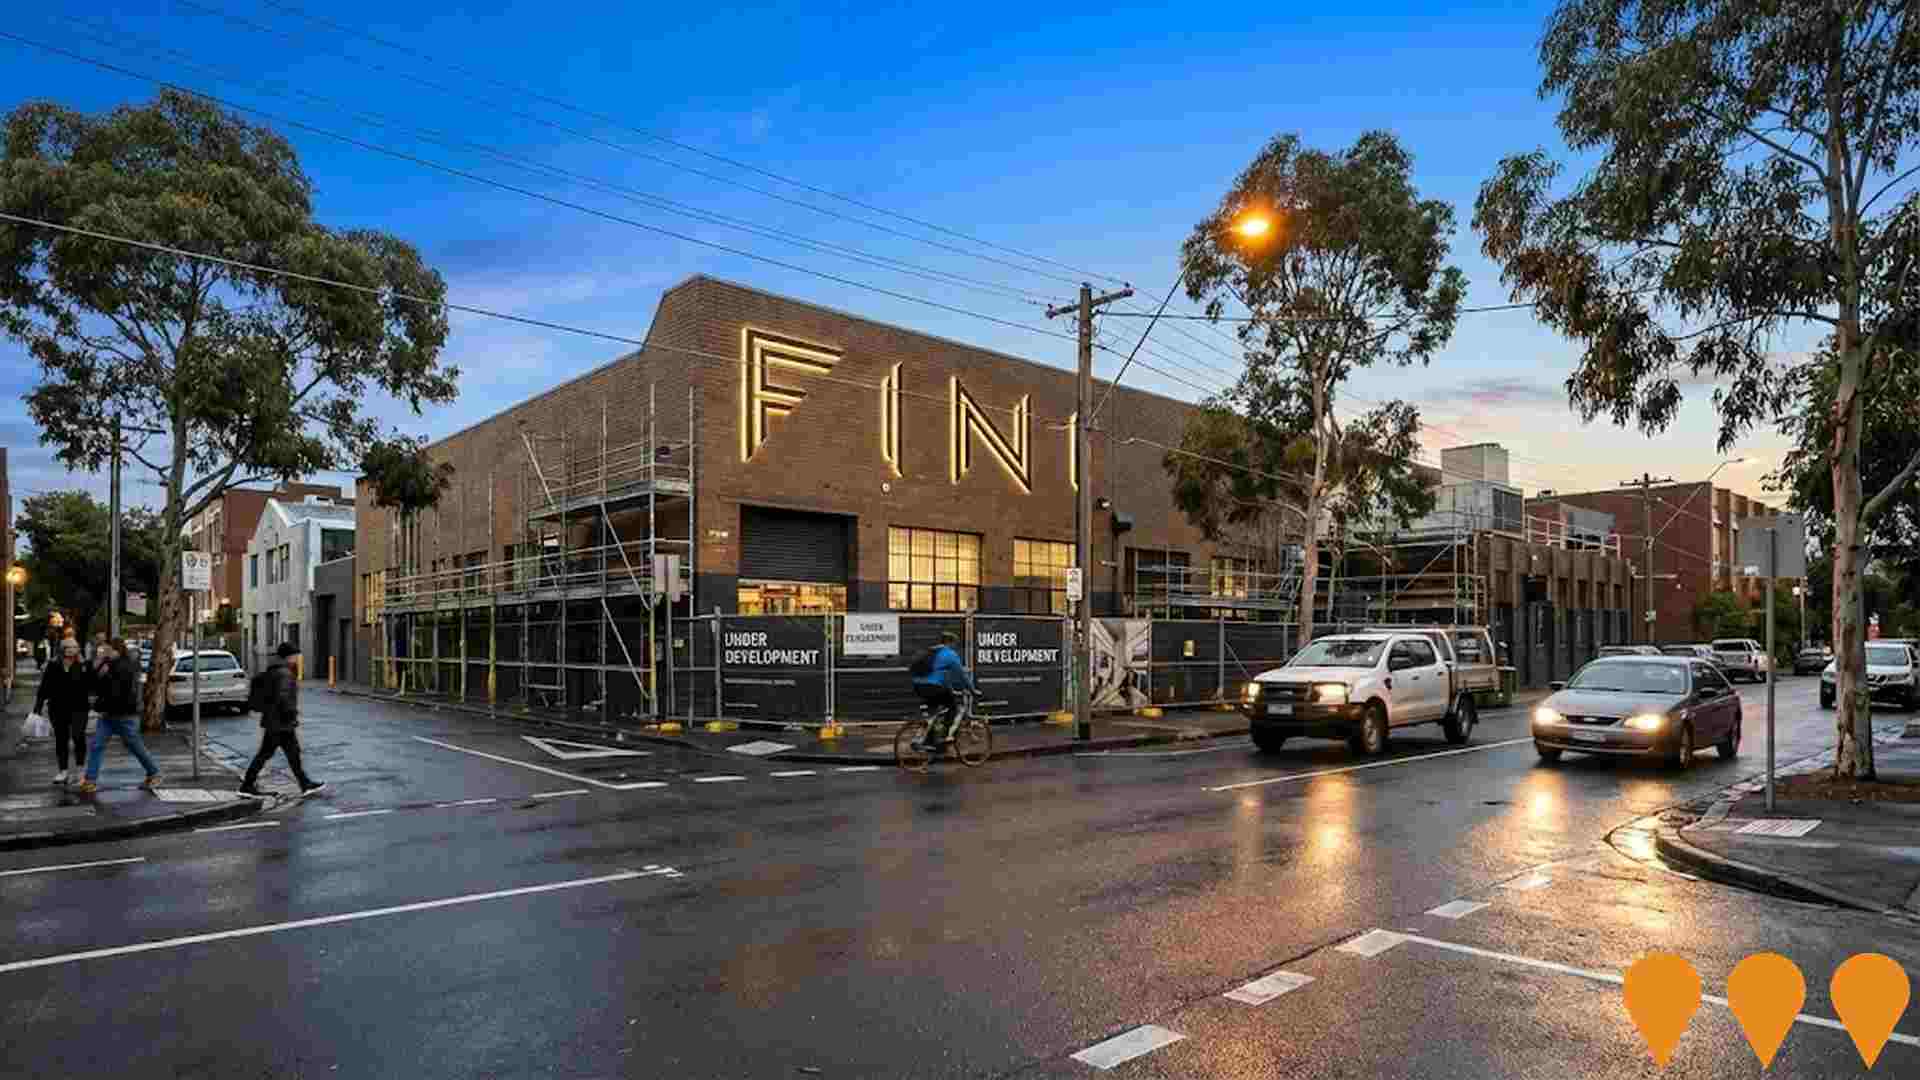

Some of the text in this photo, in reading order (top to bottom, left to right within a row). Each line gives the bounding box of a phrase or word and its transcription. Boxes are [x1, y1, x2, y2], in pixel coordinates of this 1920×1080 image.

[724, 631, 768, 648] UNDER
[977, 631, 1018, 647] UNDER
[724, 649, 820, 665] DEVELOPMENT
[977, 648, 1059, 664] DEVELOPMENT
